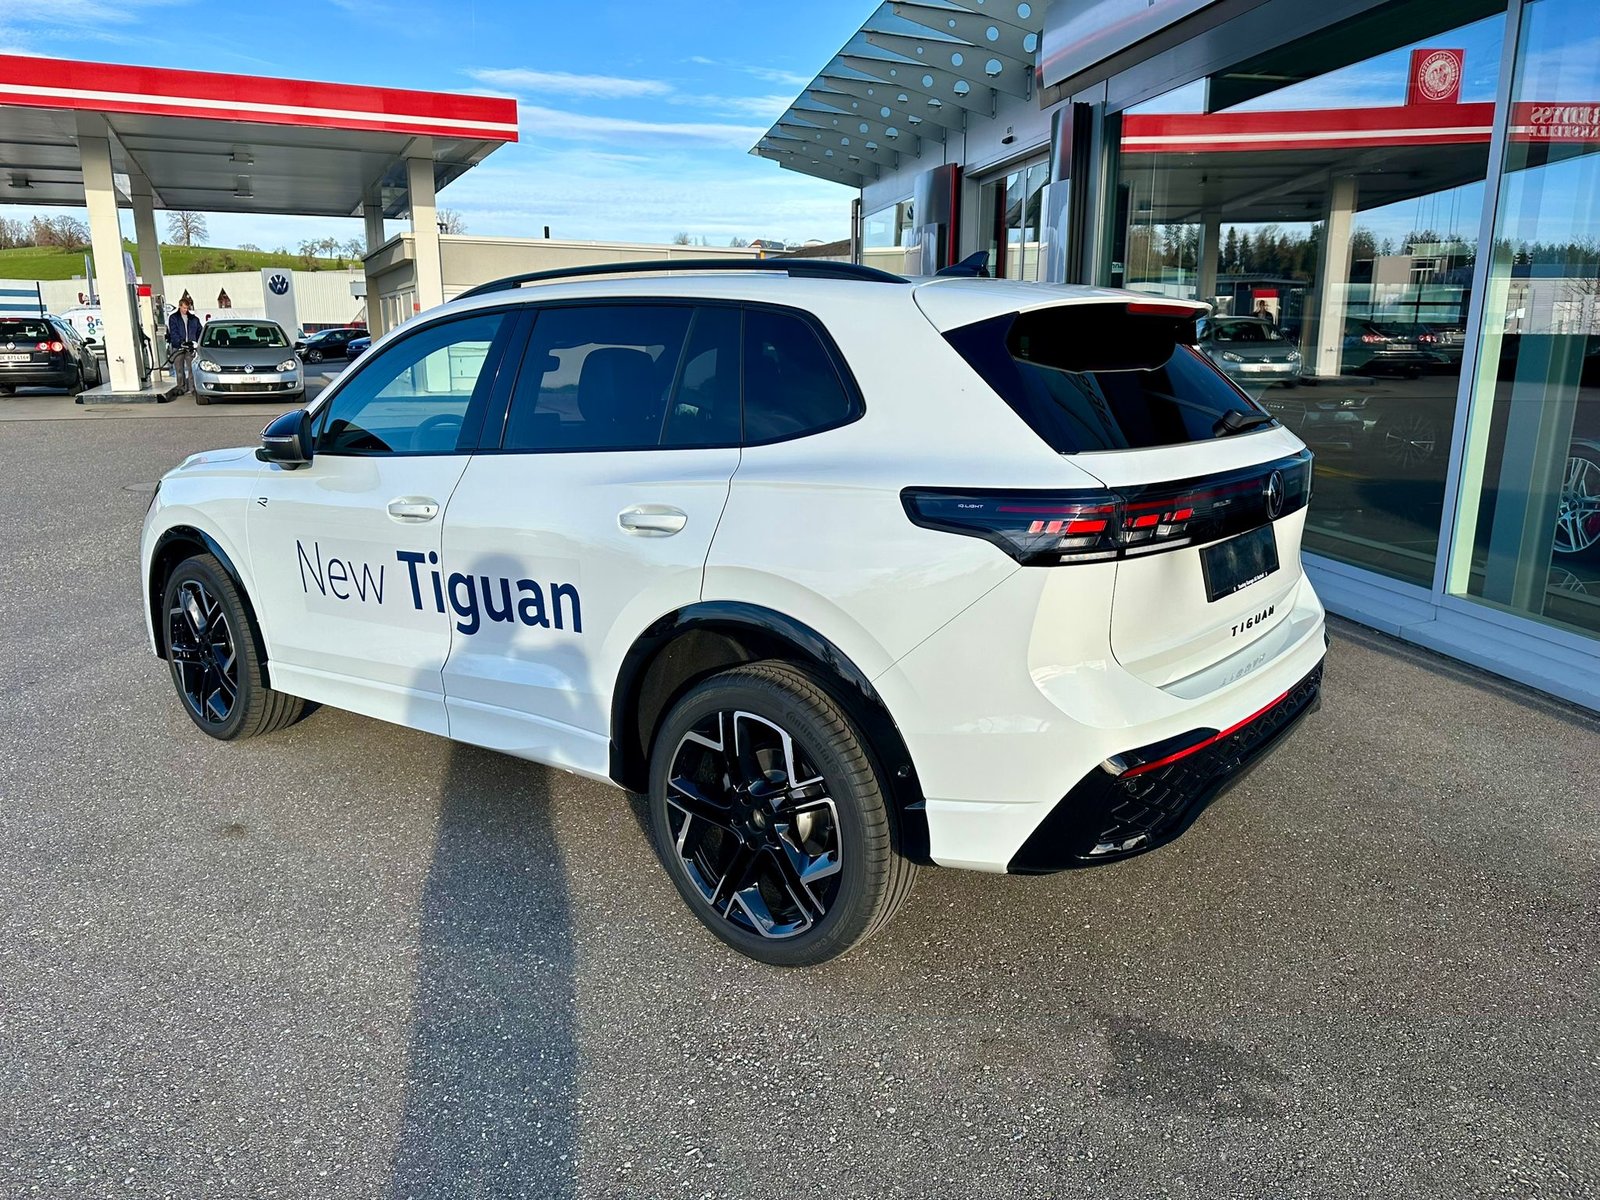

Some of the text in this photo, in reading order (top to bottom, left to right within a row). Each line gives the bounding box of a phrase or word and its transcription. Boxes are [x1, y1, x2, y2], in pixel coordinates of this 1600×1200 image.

[296, 539, 583, 636] New Tiguan
[1231, 604, 1275, 637] TIGUAN
